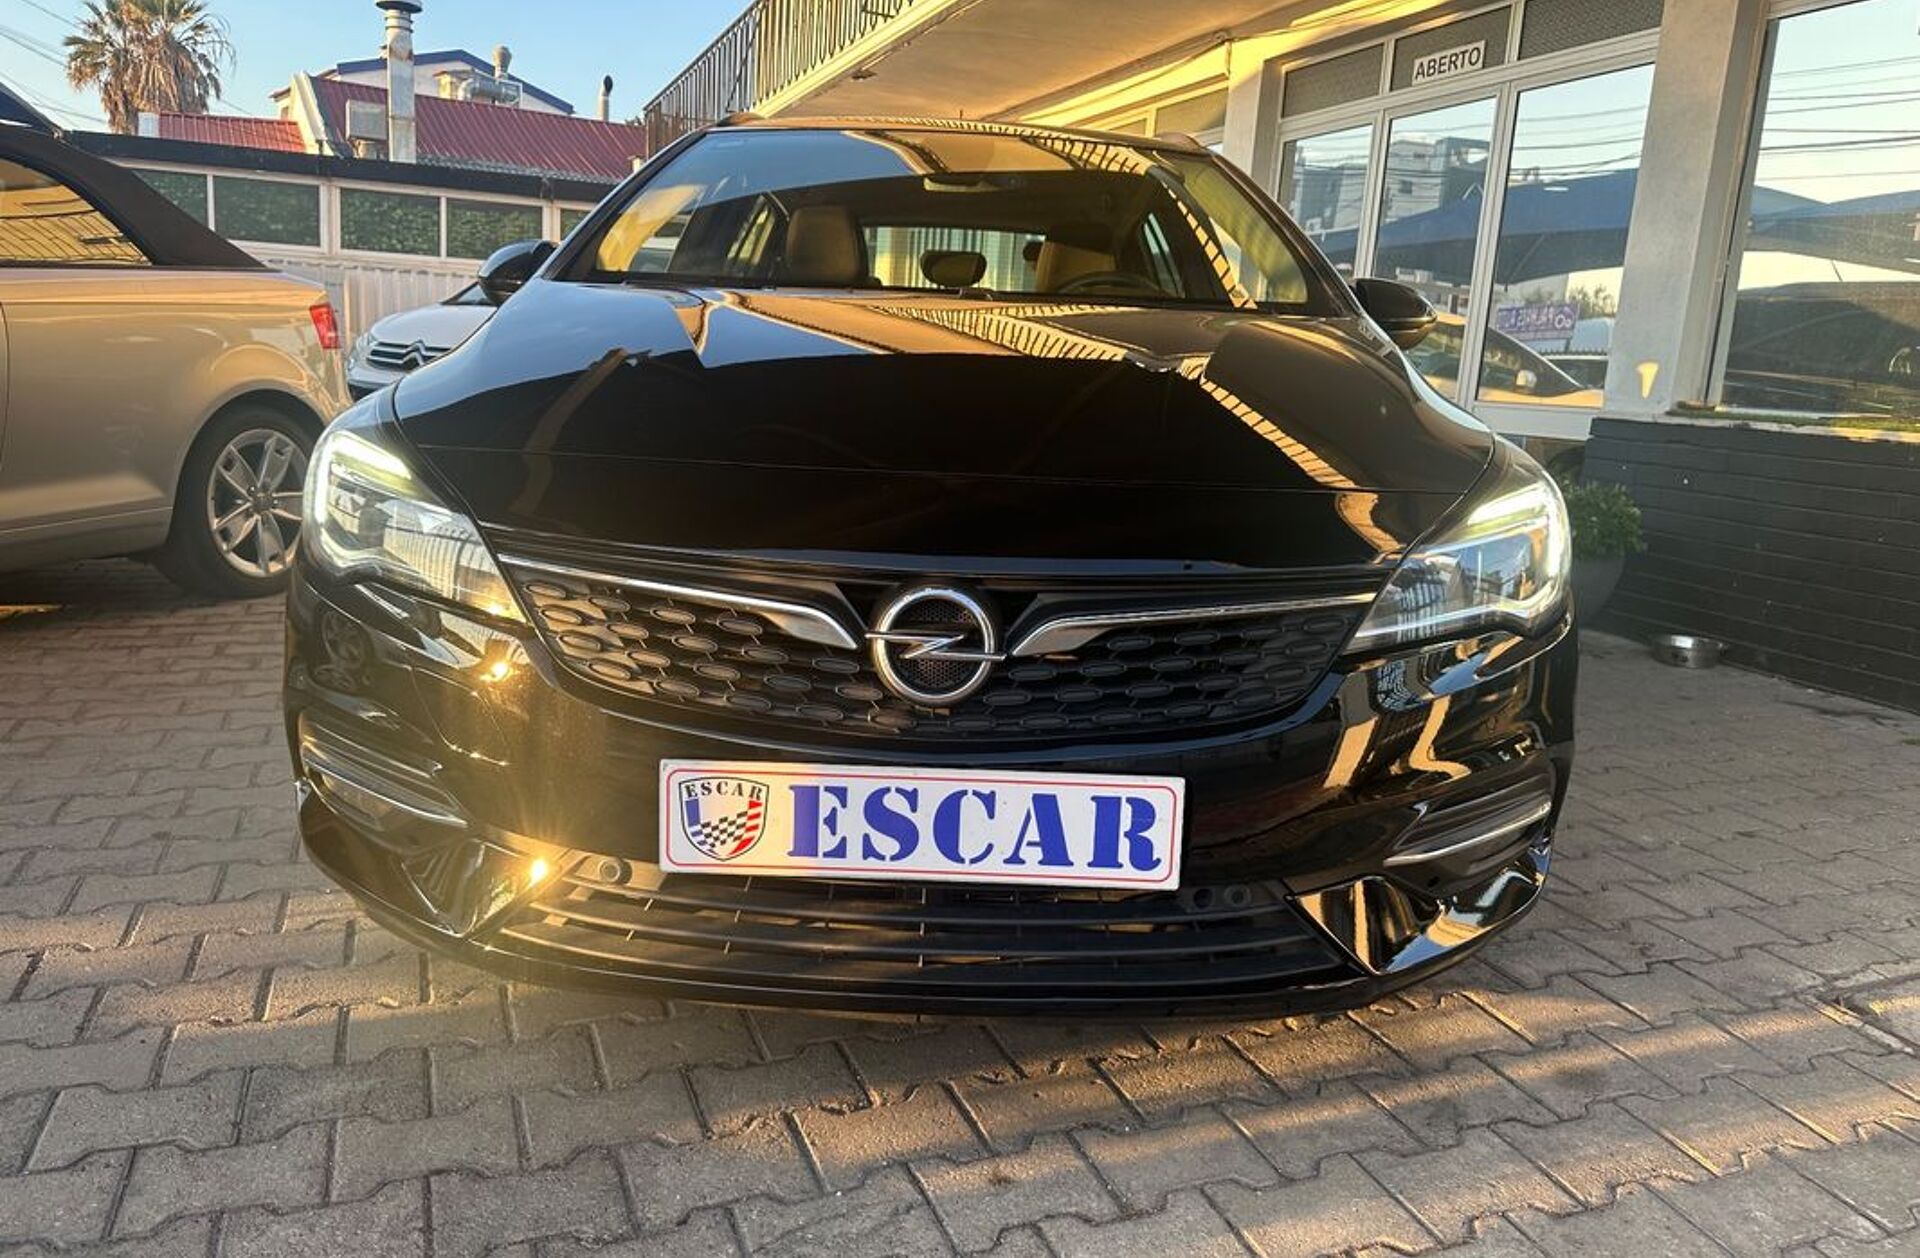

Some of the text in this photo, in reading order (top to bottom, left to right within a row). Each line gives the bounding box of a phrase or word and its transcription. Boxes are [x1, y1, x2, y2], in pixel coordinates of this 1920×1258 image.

[1415, 47, 1481, 79] ABERTO
[684, 781, 762, 800] ESCAR
[787, 785, 1162, 872] ESCAR
